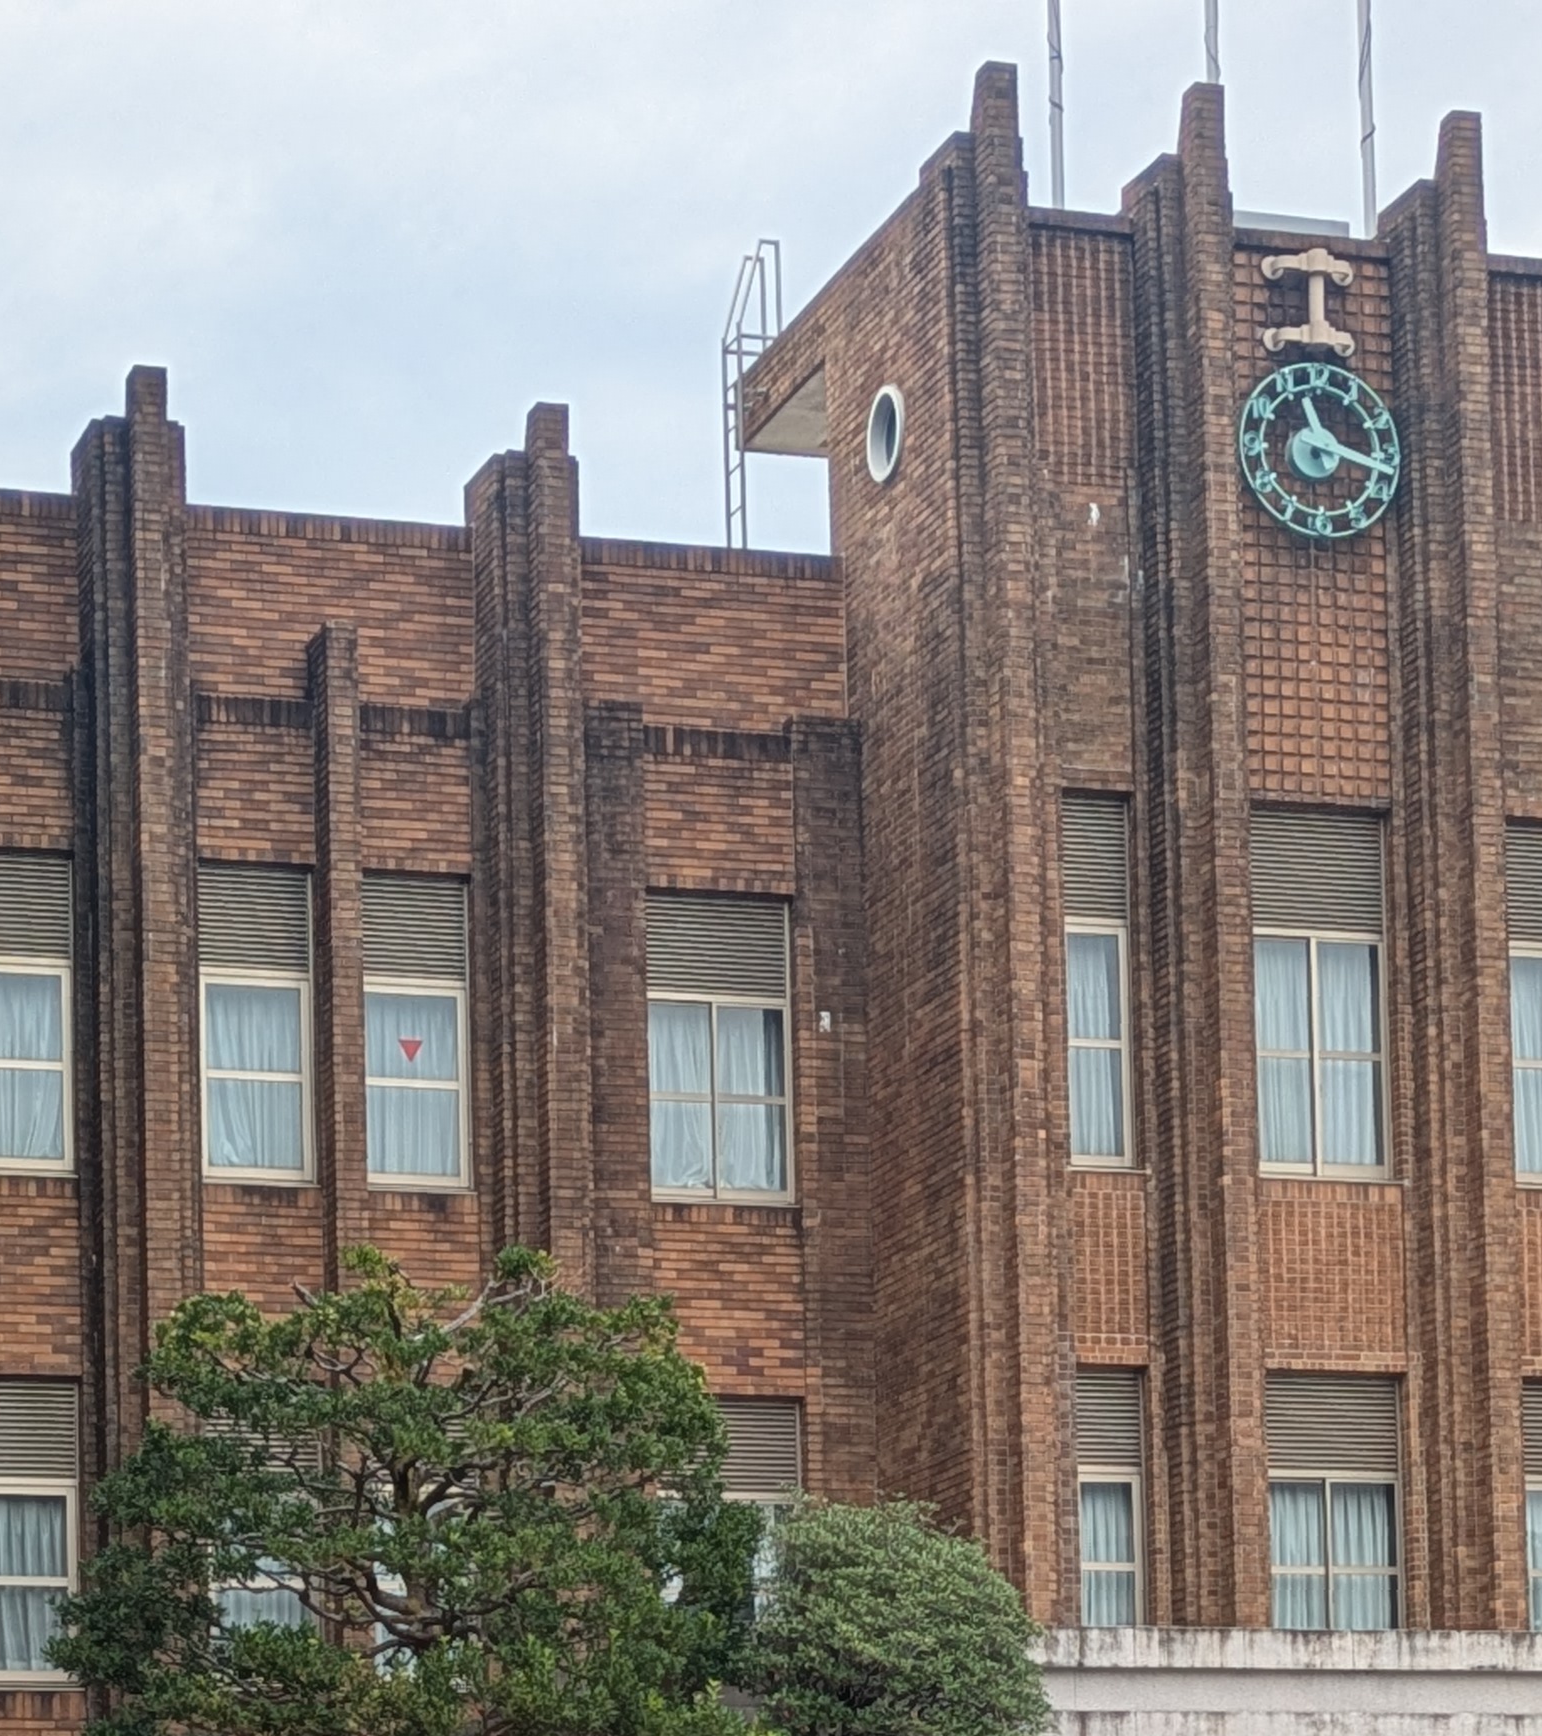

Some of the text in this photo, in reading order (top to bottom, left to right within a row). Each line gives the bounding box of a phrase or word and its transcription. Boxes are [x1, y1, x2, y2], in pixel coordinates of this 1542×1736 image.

[1275, 368, 1295, 393] 11
[1307, 363, 1329, 387] 12
[1348, 378, 1359, 400] 1
[1251, 394, 1271, 418] 10
[1373, 406, 1390, 429] 2
[1244, 430, 1260, 456] 9
[1382, 443, 1400, 466] 3
[1256, 470, 1273, 493] 8
[1370, 481, 1389, 501] 4
[1281, 498, 1296, 521] 7
[1349, 504, 1367, 528] 5
[1314, 513, 1333, 535] 6
